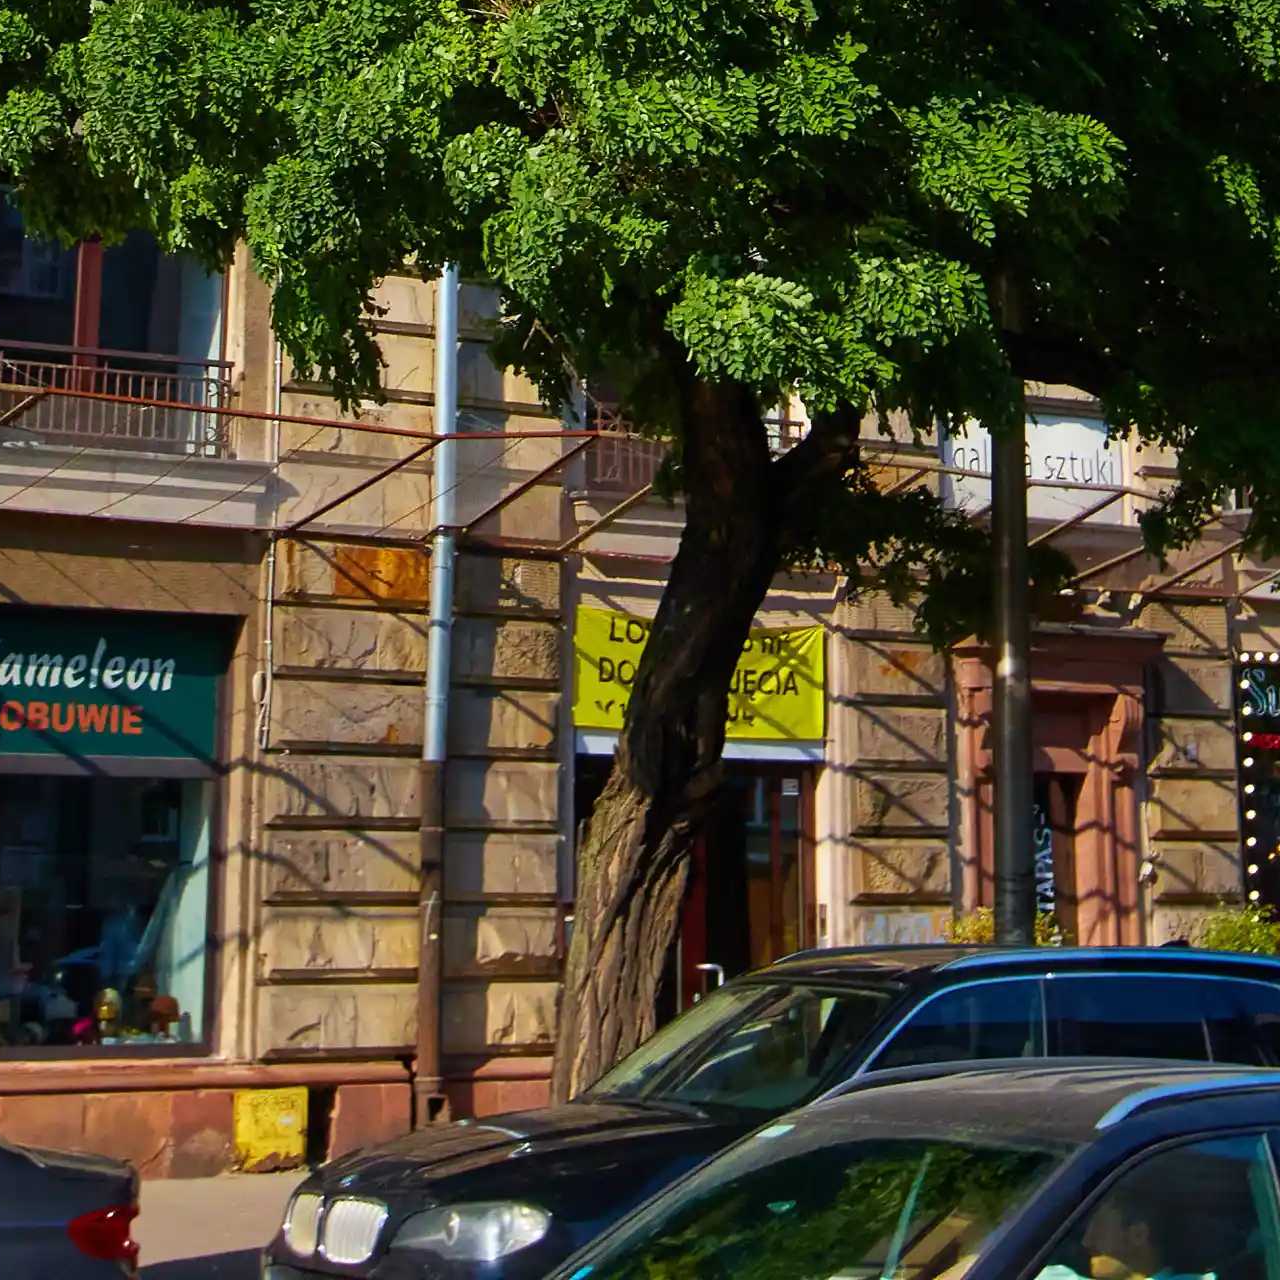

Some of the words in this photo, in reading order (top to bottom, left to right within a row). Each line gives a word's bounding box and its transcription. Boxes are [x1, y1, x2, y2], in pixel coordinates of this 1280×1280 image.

[953, 439, 1033, 483] gala
[1044, 448, 1115, 486] sztuki
[0, 699, 144, 735] OBUWIE
